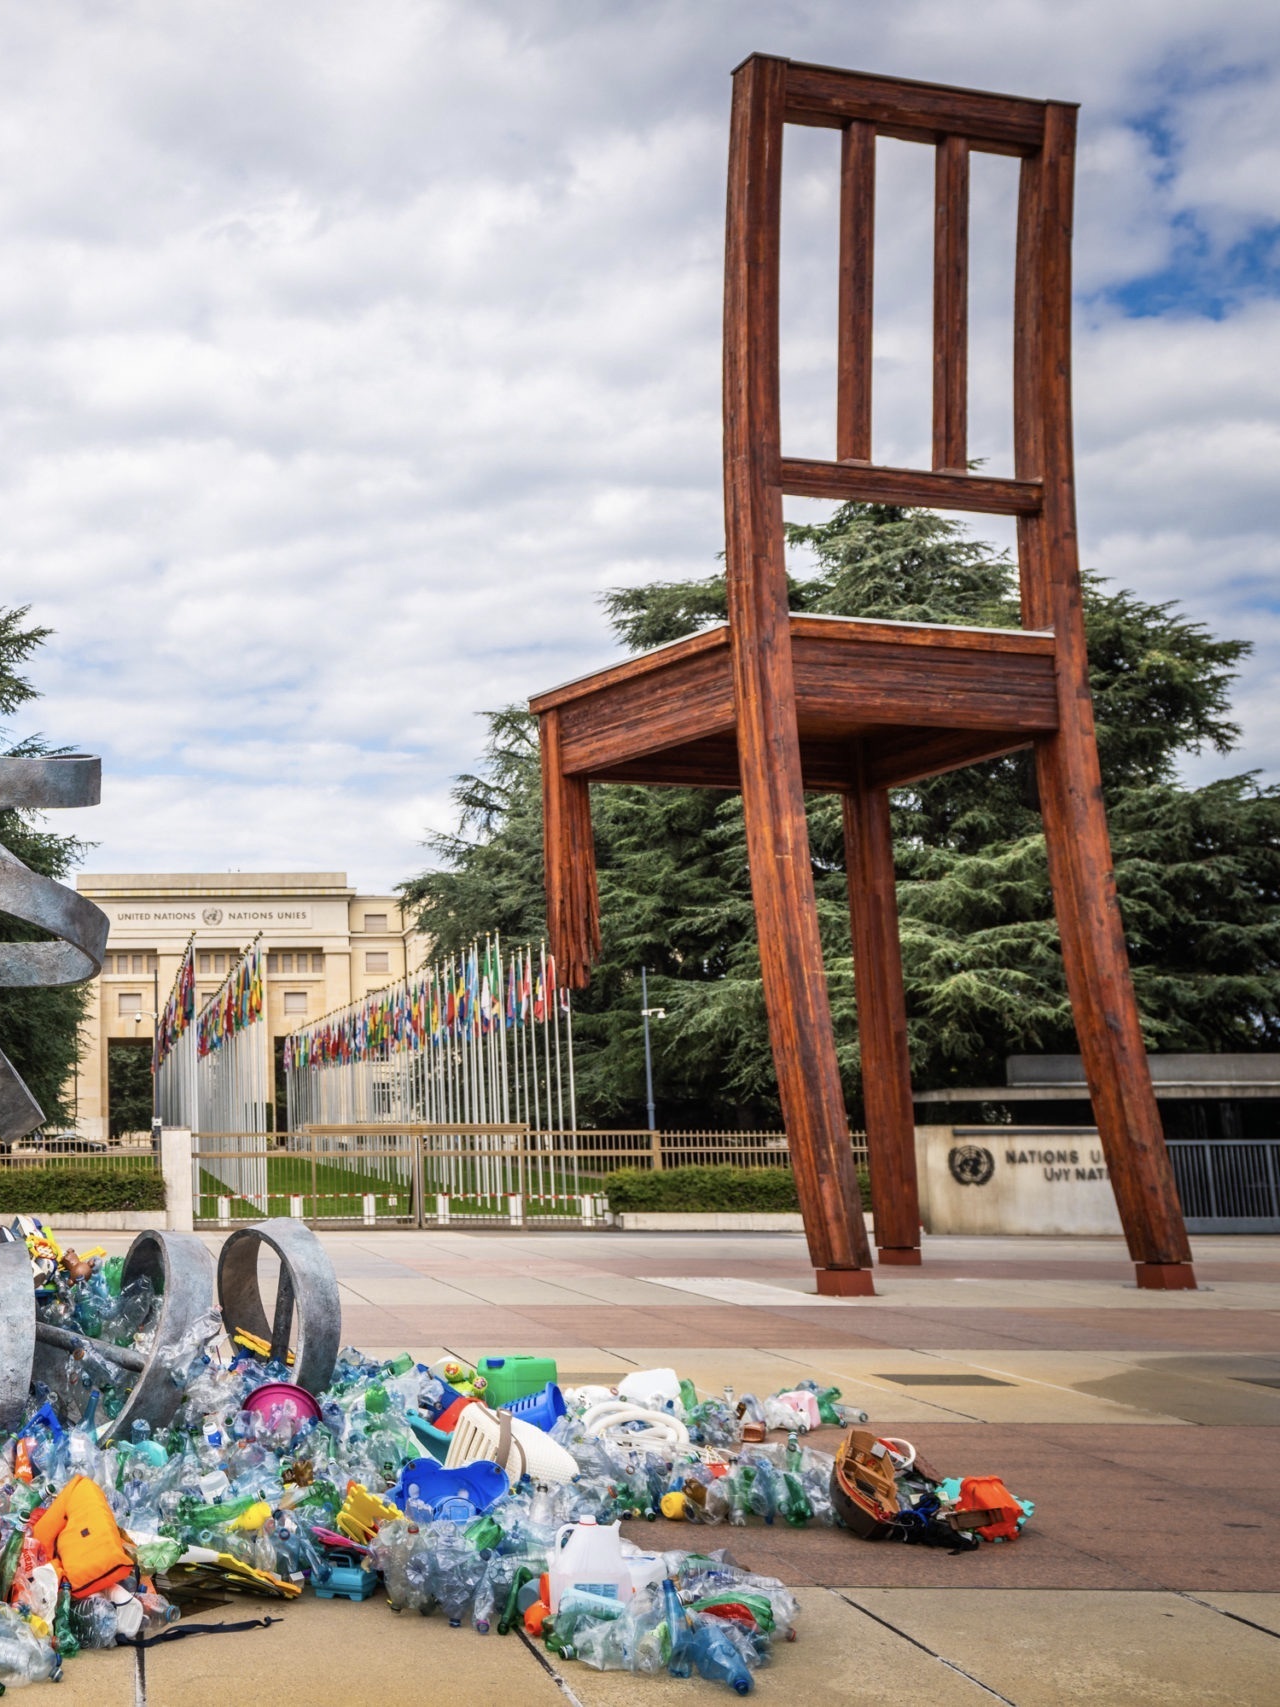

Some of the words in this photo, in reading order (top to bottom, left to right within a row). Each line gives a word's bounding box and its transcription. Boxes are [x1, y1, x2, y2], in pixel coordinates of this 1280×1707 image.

[117, 912, 151, 921] UNITED
[153, 912, 196, 920] NATIONS
[228, 912, 273, 920] NATIONS
[277, 911, 307, 920] UNIES
[1005, 1150, 1079, 1164] NATIONS
[1075, 1167, 1111, 1180] NATI
